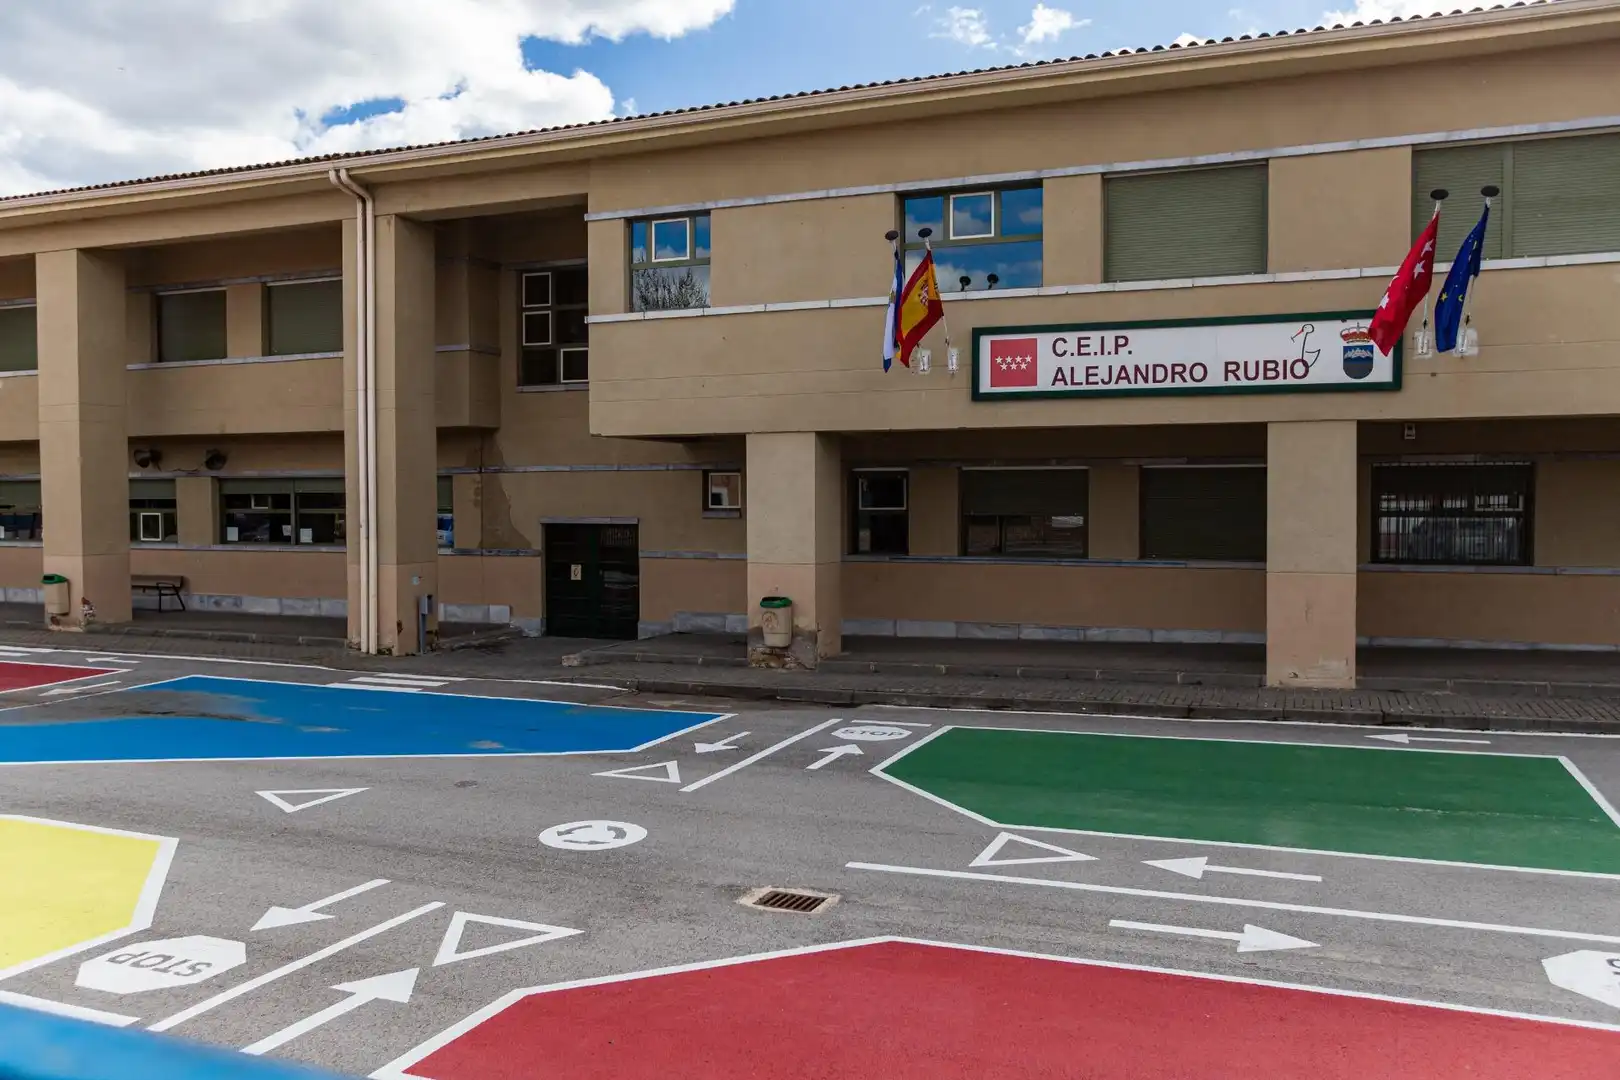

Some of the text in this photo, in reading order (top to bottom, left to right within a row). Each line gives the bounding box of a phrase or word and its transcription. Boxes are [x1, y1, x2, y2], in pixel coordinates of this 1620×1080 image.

[1052, 335, 1132, 357] C.E.I.P.
[1051, 358, 1310, 386] ALEJANDRO RUBIO
[841, 729, 903, 737] STOP
[106, 951, 213, 977] STOP
